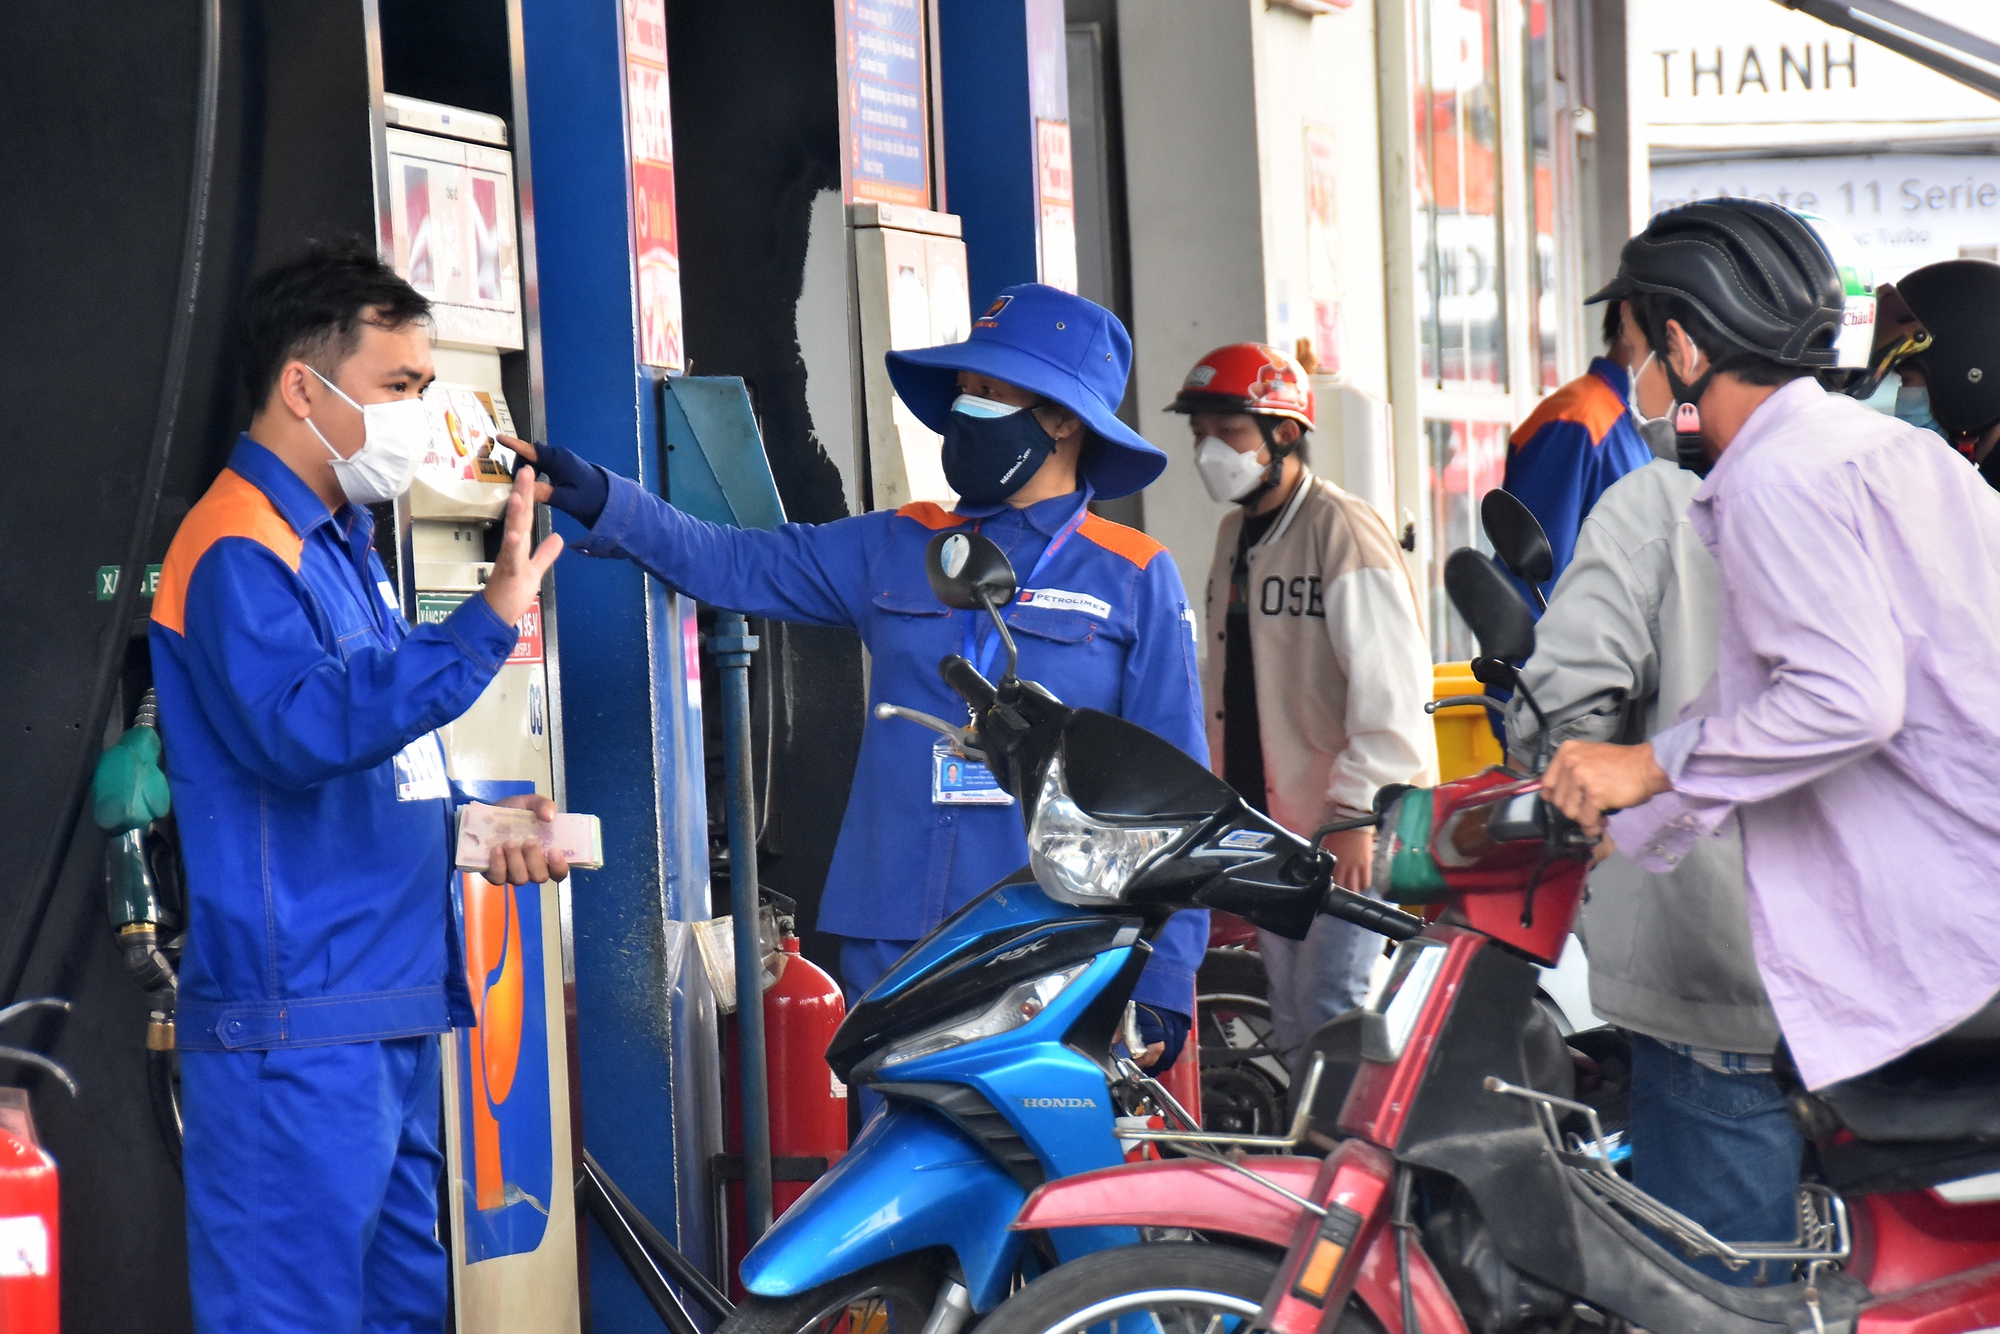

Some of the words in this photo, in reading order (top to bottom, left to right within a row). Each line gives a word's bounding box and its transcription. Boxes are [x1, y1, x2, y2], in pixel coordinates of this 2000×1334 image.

[1652, 41, 1856, 97] THANH
[1838, 180, 1881, 214] 11
[1036, 594, 1106, 612] PETROLIMEX
[529, 684, 543, 735] 03
[1022, 1097, 1097, 1108] HONDA
